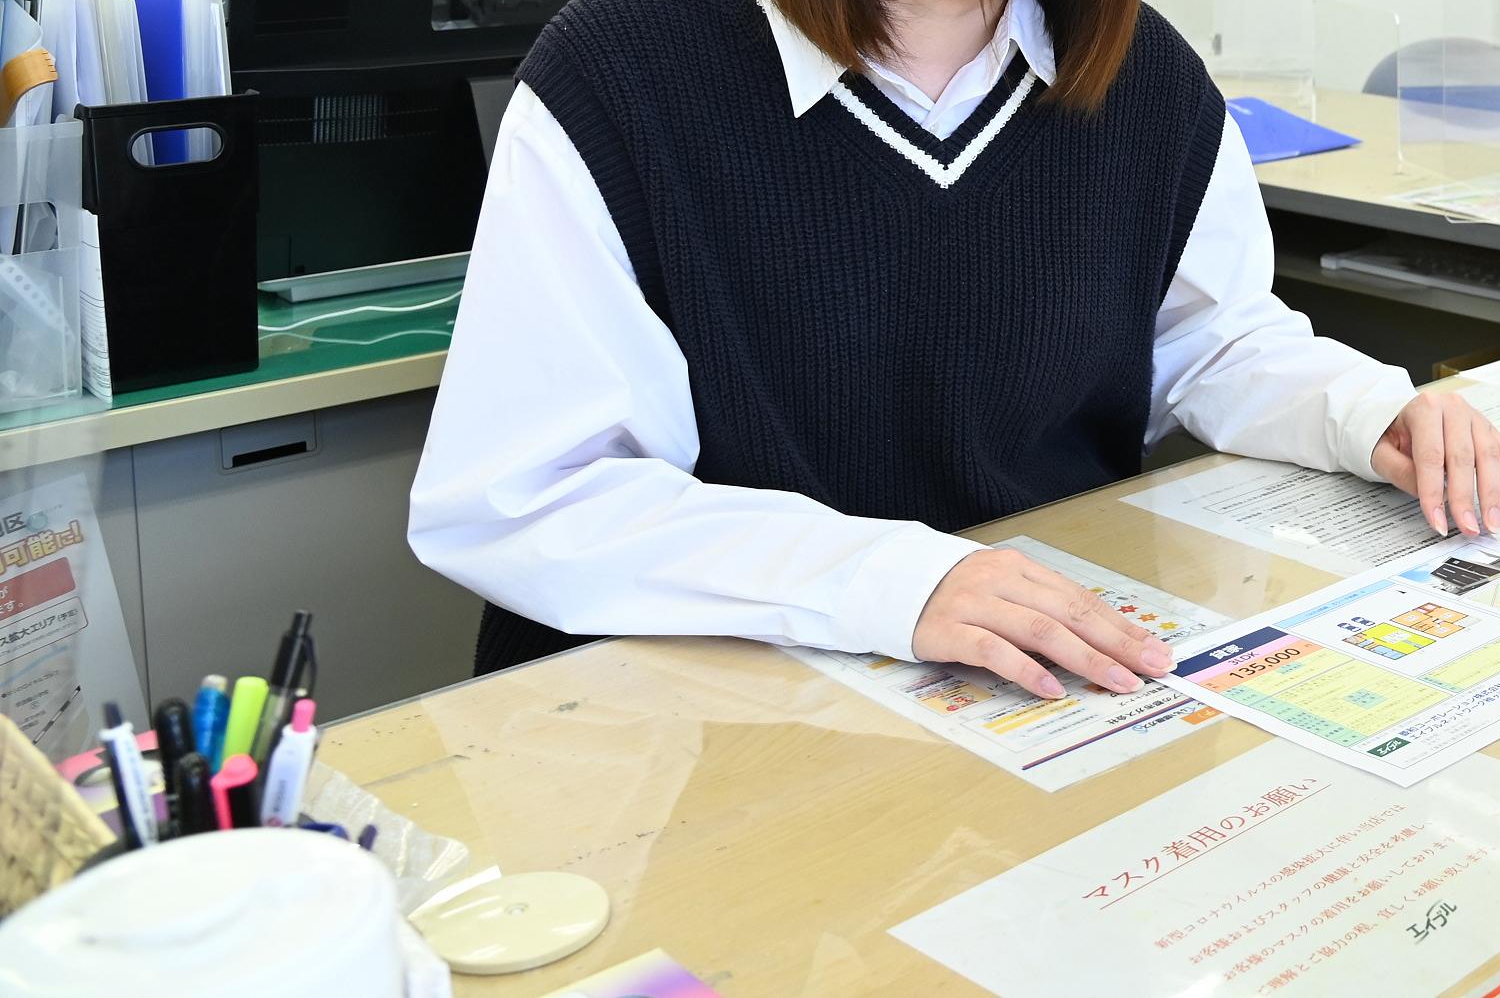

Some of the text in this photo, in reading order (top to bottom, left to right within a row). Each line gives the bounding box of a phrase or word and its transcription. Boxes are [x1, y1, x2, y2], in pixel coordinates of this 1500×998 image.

[0, 511, 27, 538] 区
[0, 519, 84, 576] 可能に!
[1228, 650, 1260, 666] 3LDK
[1229, 647, 1301, 680] 135,000
[1082, 776, 1318, 901] マスク着用のお願い
[1406, 900, 1458, 945] エイブル
